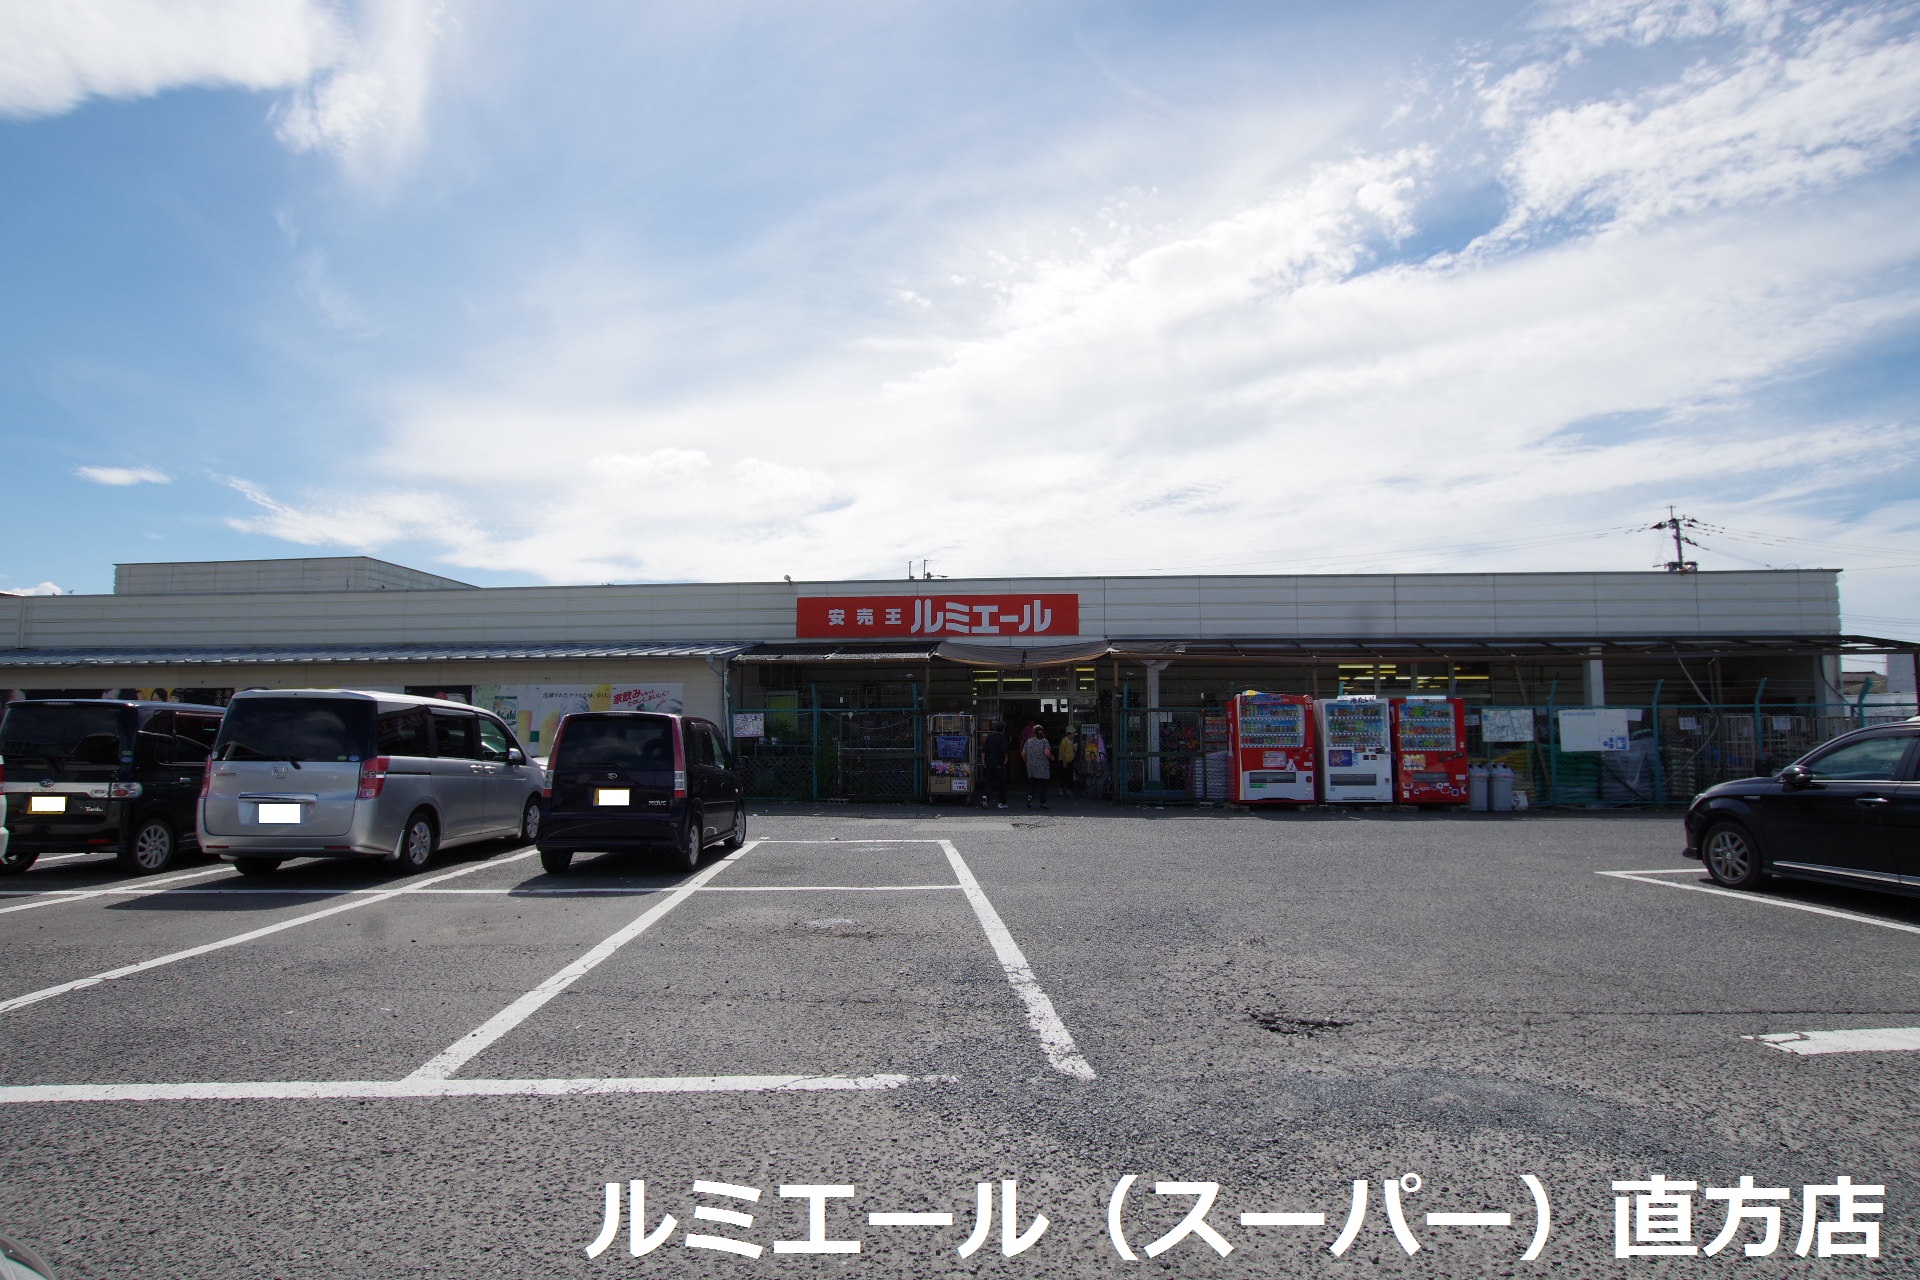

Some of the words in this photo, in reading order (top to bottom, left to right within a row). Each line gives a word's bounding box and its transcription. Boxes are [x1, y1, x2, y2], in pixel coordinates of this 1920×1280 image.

[829, 608, 903, 626] 安売王
[911, 598, 1052, 634] ルミエール
